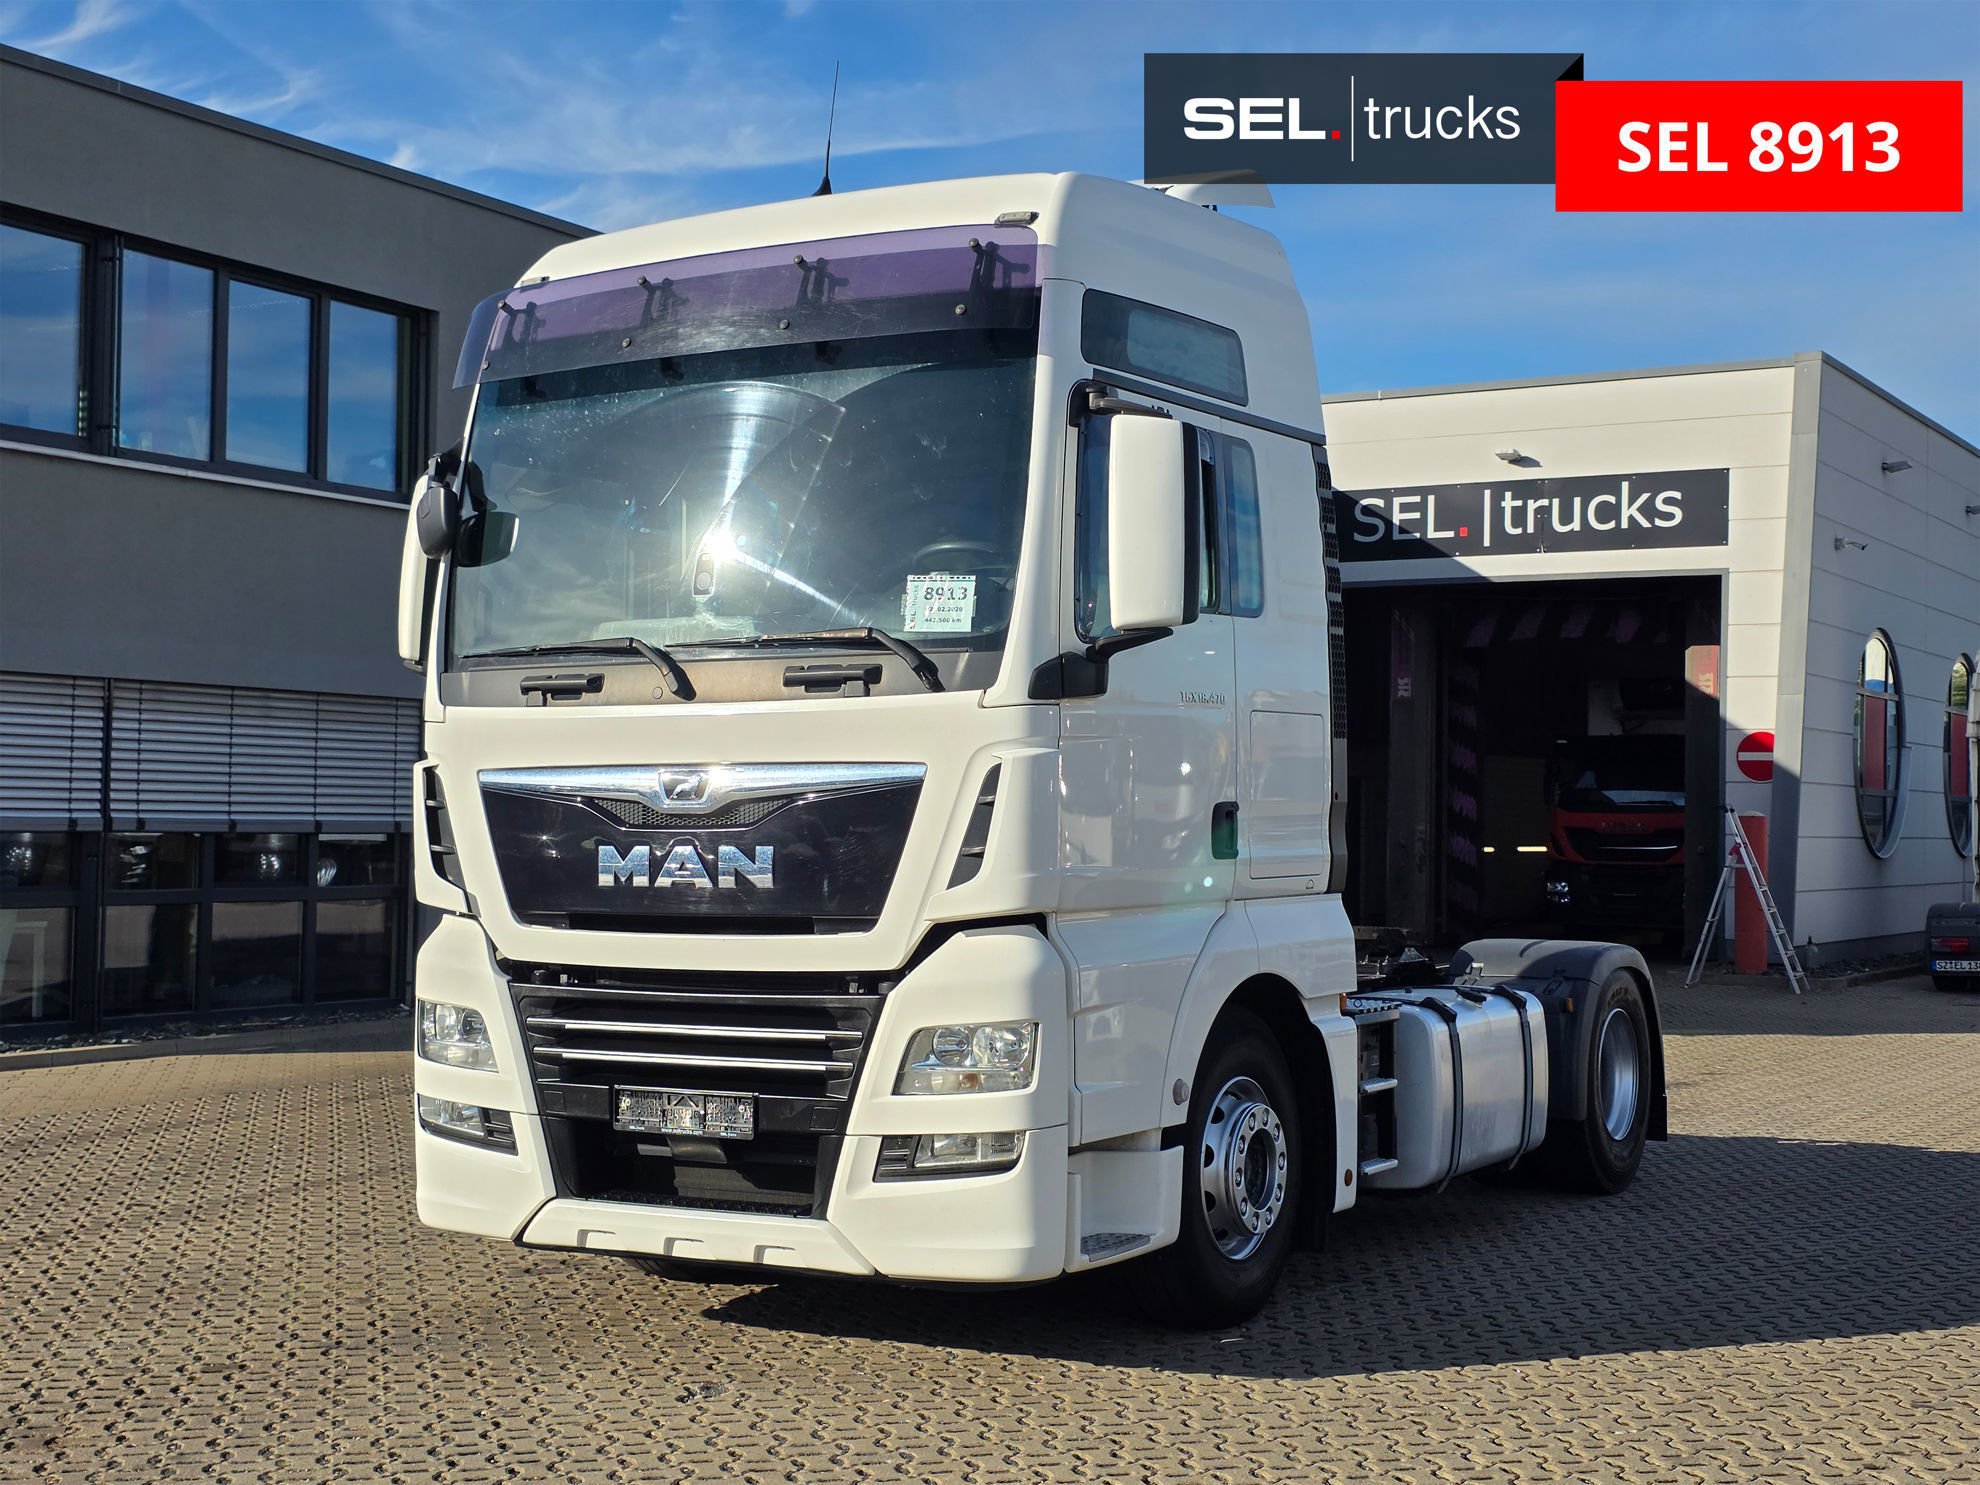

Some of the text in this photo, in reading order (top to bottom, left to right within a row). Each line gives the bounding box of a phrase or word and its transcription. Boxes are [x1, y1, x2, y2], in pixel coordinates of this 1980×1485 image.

[1501, 480, 1683, 535] trucks
[924, 586, 968, 600] 8913
[598, 845, 775, 889] MAN
